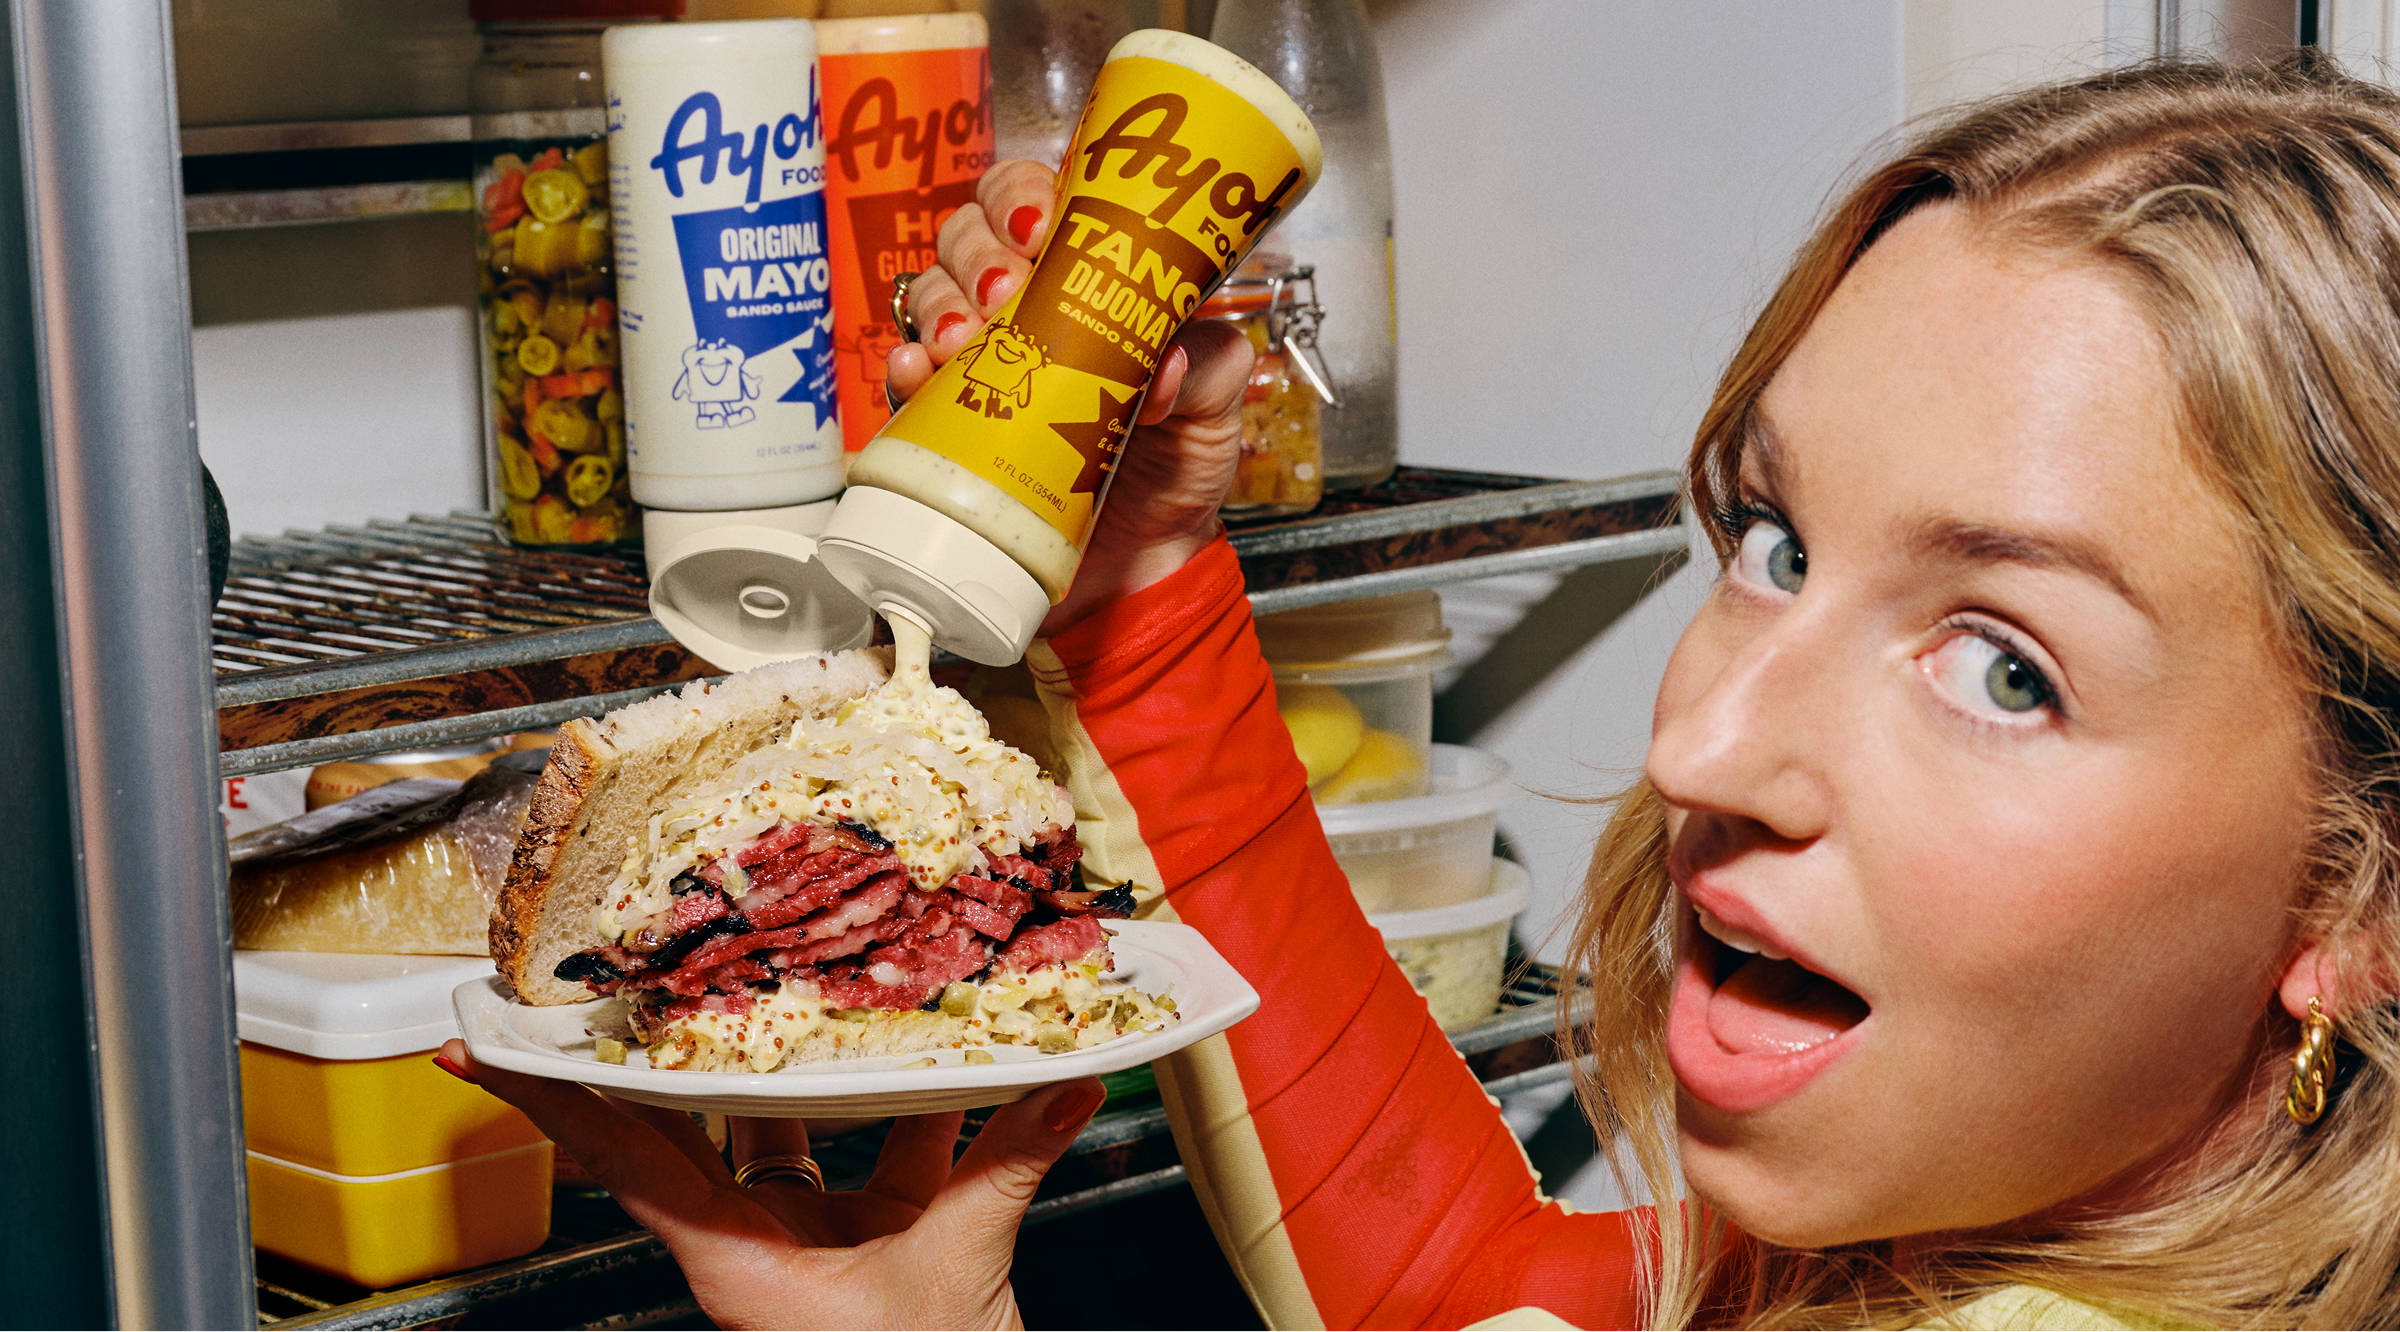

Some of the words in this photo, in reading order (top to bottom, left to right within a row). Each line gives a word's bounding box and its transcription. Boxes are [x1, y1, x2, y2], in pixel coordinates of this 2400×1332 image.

[952, 151, 995, 172] FOO
[720, 221, 821, 262] ORIGINAL
[703, 257, 830, 302] MAYO
[726, 302, 784, 318] SANDO
[785, 297, 824, 314] SAUCE
[1058, 301, 1120, 344] SANDO
[993, 456, 1005, 469] 12
[1004, 463, 1016, 478] FL
[1018, 472, 1034, 488] OZ
[1032, 481, 1067, 514] (354ML)
